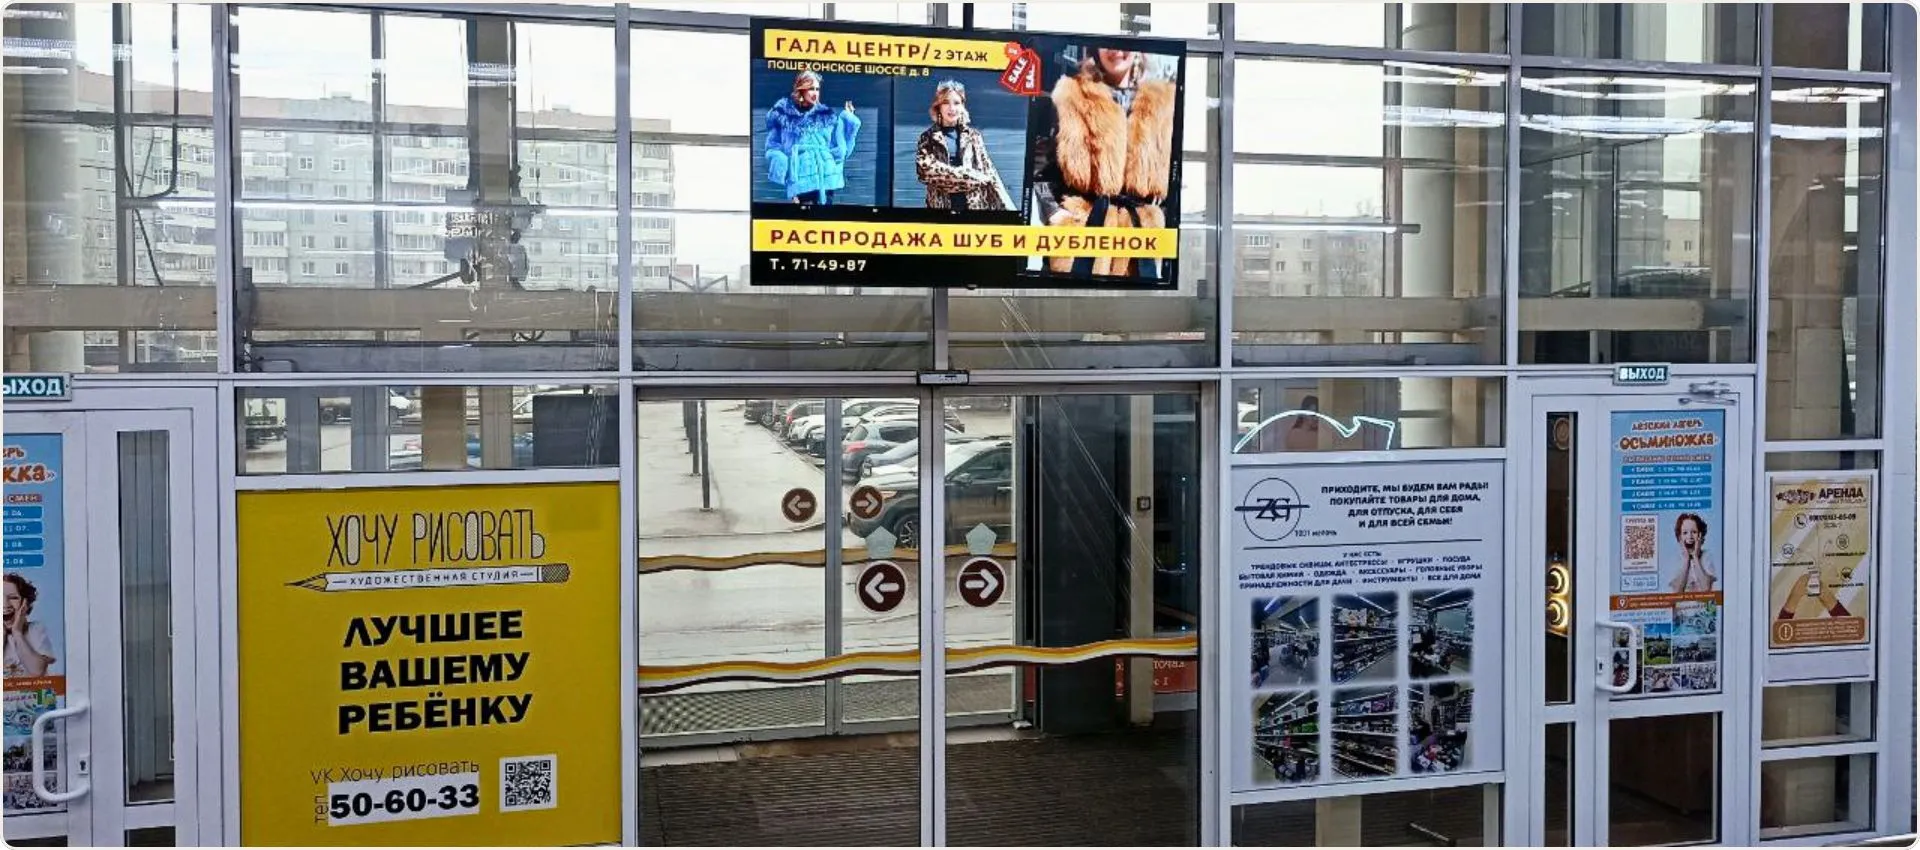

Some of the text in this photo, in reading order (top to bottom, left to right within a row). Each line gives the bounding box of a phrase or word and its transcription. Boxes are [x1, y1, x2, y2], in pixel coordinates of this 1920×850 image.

[776, 37, 837, 54] ГАЛА
[934, 49, 942, 60] 2
[945, 50, 989, 62] ЭТАЖ
[767, 59, 863, 75] ПОШЕХОНСКОЕ
[864, 65, 907, 76] ШОССЕ
[923, 67, 930, 77] 8
[1008, 57, 1028, 84] SALE
[1025, 63, 1036, 89] SAL
[770, 229, 1158, 252] РАСПРОДАЖА ШУБ И ДУБЛЕНОК
[769, 258, 867, 272] Т. 71-49-87
[1619, 367, 1665, 380] ВЫХОД
[1321, 485, 1381, 494] ПРИХОДИТЕ,
[1402, 484, 1435, 492] БУДЕМ
[1459, 482, 1488, 490] РАДЫ!
[1330, 495, 1386, 505] ПОКУПАЙТЕ
[1429, 495, 1449, 503] ДЛЯ
[1451, 494, 1481, 502] ДОМА,
[1818, 487, 1863, 498] АРЕНДА
[1348, 508, 1369, 517] ДЛЯ
[1371, 508, 1415, 516] ОТПУСКА,
[1417, 507, 1437, 515] ДЛЯ
[1368, 520, 1388, 528] ДЛЯ
[1390, 517, 1415, 527] ВСЕЙ
[1417, 518, 1452, 526] СЕМЬИ!
[327, 509, 546, 567] ХОЧУ РИСОВАТЬ
[350, 570, 519, 585] ХУДОЖЕСТВЕННАЯ СТУДИЯ
[343, 610, 524, 648] ЛУЧШЕЕ
[340, 652, 530, 691] ВАШЕМУ
[338, 691, 534, 735] РЕБЁНКУ
[310, 760, 480, 784] VK Хочу рисовать
[330, 783, 480, 819] 50-60-33
